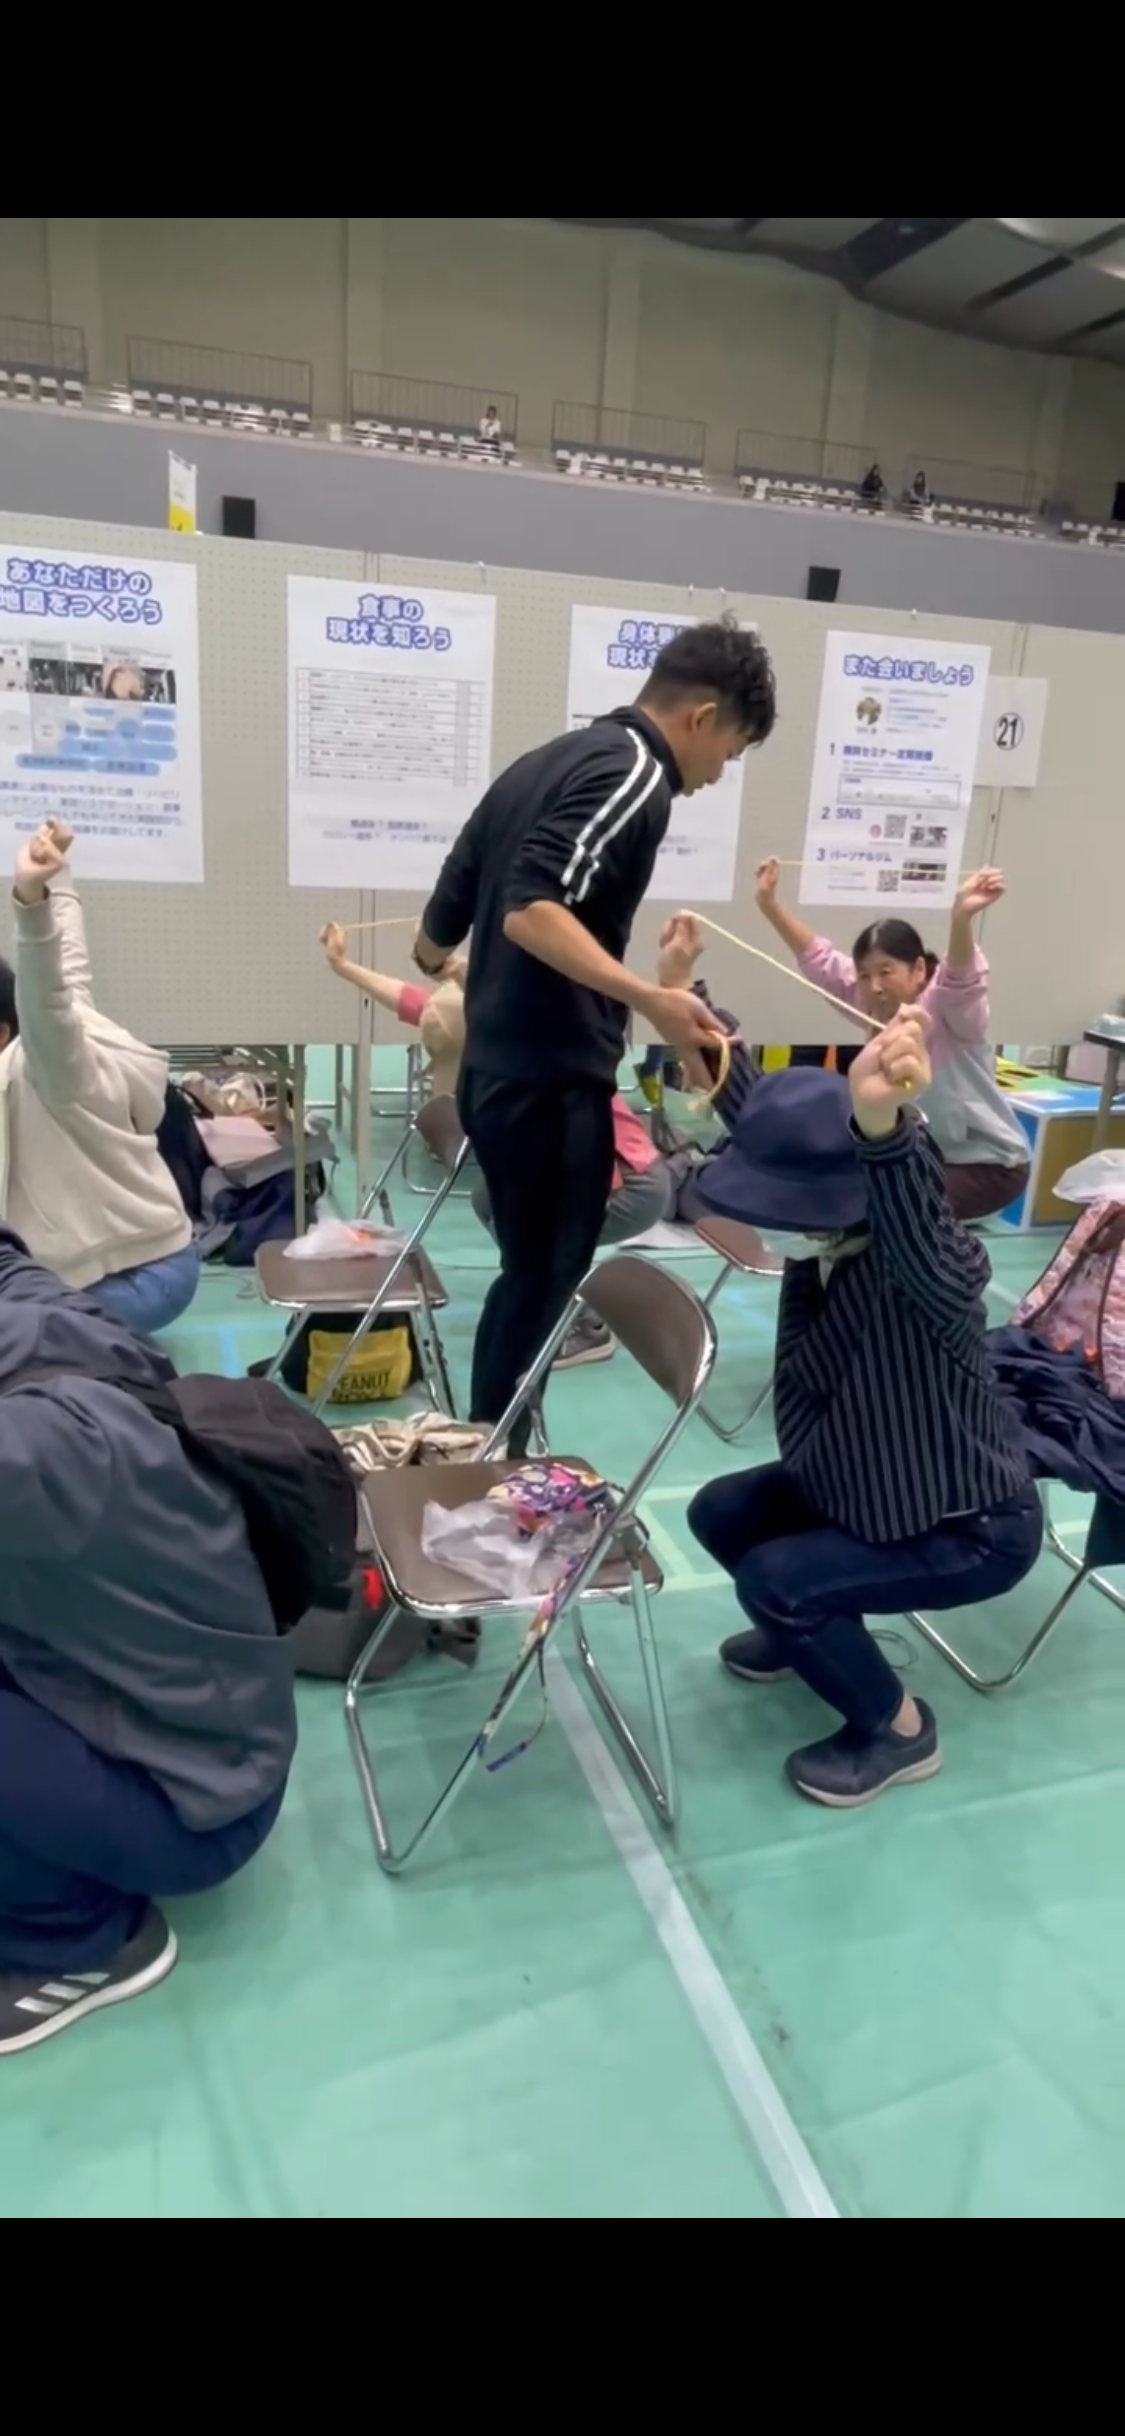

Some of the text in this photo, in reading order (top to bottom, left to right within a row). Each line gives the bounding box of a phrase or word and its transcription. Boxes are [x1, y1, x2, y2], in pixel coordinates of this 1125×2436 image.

[7, 558, 152, 595] あなただけの
[0, 585, 162, 625] 地図をつくろう
[358, 593, 424, 622] 食事の
[326, 616, 452, 651] 現状を知ろう
[844, 654, 974, 686] また会いましょう
[996, 716, 1019, 748] 21
[820, 806, 862, 820] 2 SNS
[816, 848, 826, 862] 3
